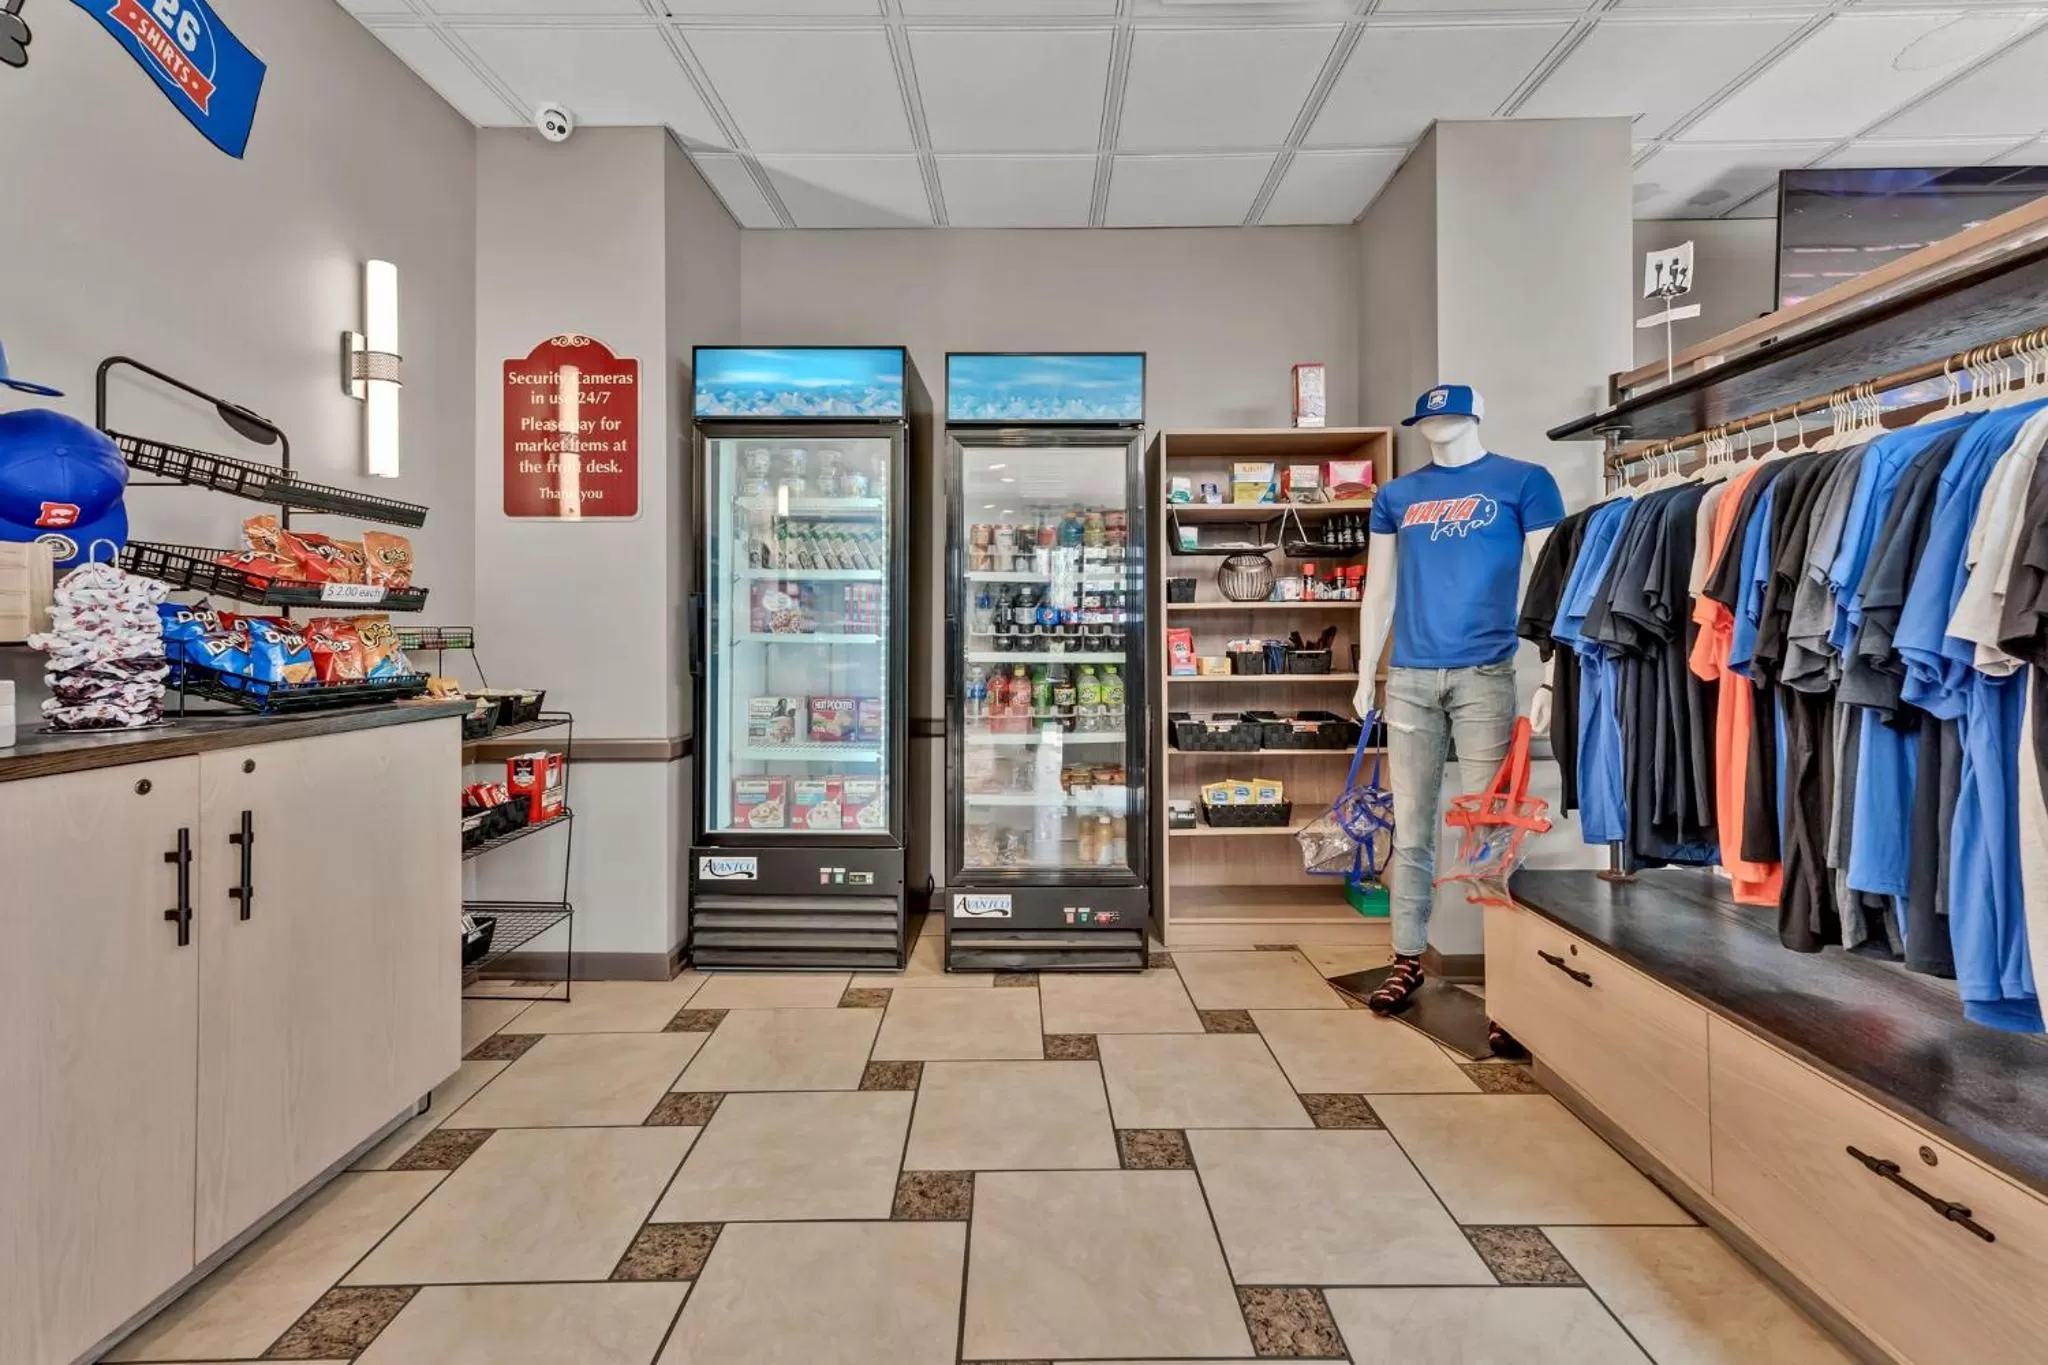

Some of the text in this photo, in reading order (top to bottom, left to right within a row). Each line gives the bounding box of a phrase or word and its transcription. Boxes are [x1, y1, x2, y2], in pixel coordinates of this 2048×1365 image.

[152, 0, 200, 52] 26
[137, 19, 191, 84] SHIRTS
[508, 371, 568, 387] Securit
[530, 390, 545, 405] in
[577, 391, 611, 405] 24/7
[600, 416, 622, 431] for
[613, 440, 627, 452] at
[519, 459, 623, 473] the frot desk.
[539, 486, 603, 503] Than you
[1401, 497, 1481, 528] MAFIA
